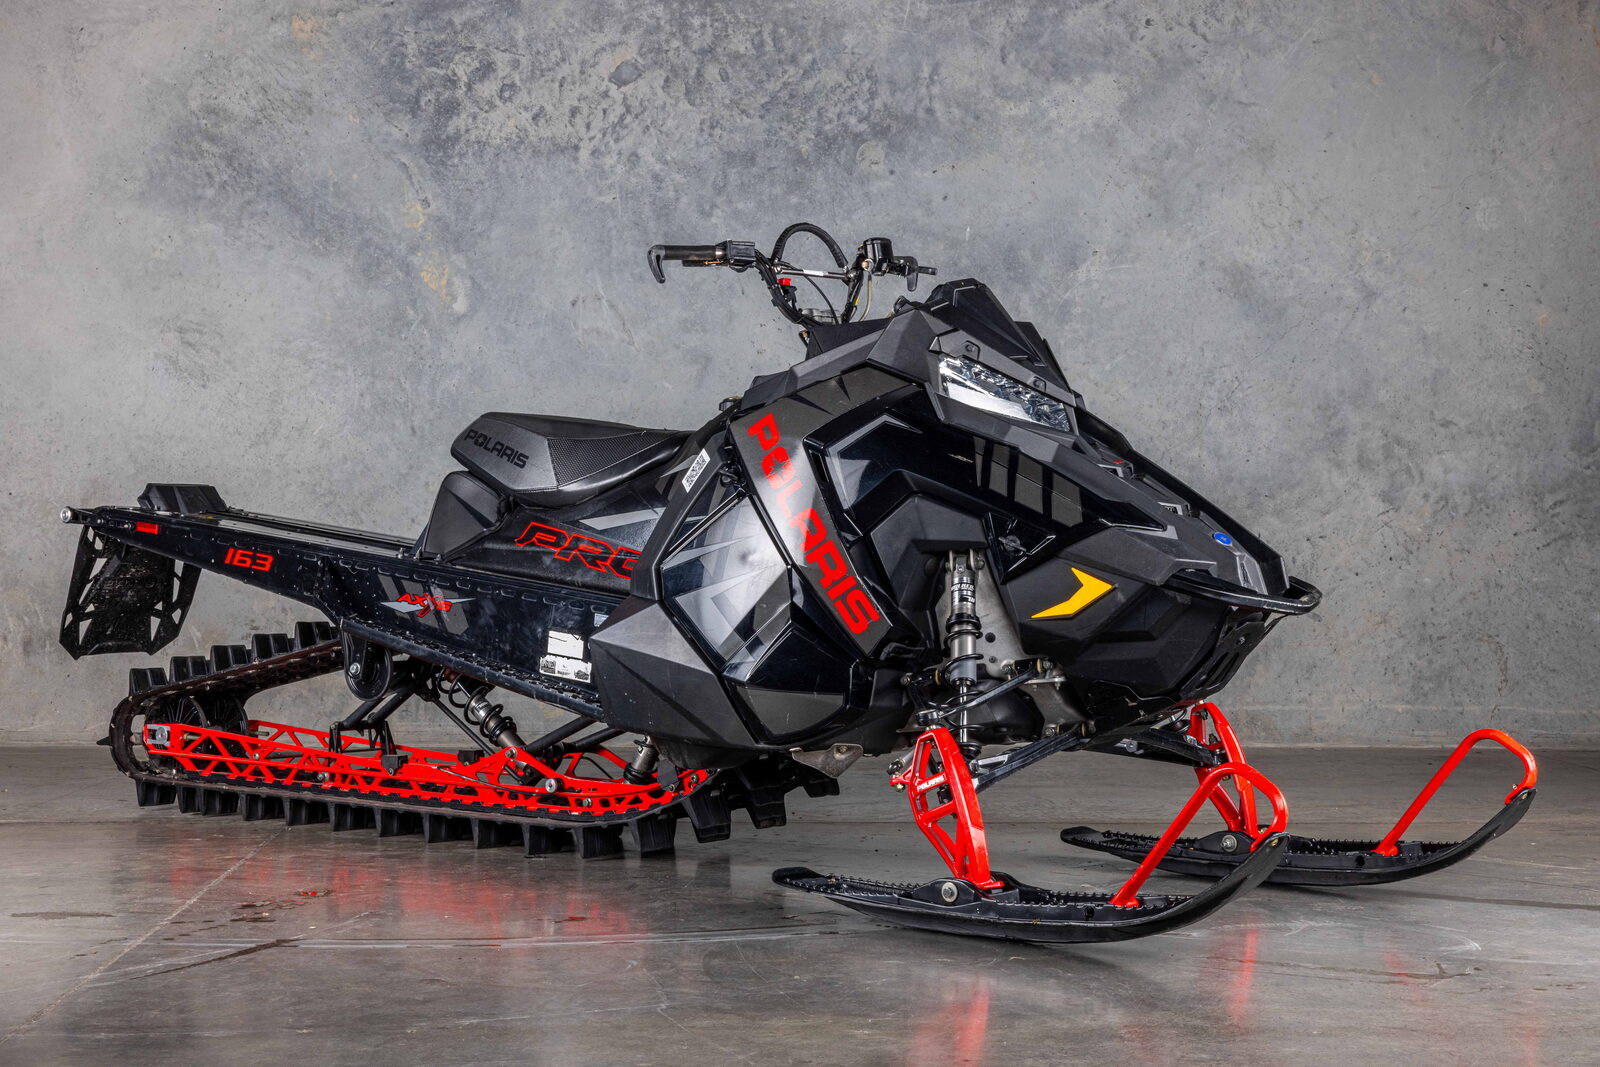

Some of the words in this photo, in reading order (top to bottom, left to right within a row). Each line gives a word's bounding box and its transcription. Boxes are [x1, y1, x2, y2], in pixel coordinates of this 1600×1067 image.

[464, 429, 529, 469] POLARIS
[748, 412, 881, 635] POLARIS
[224, 548, 274, 572] 163
[916, 774, 946, 792] POLARIS
